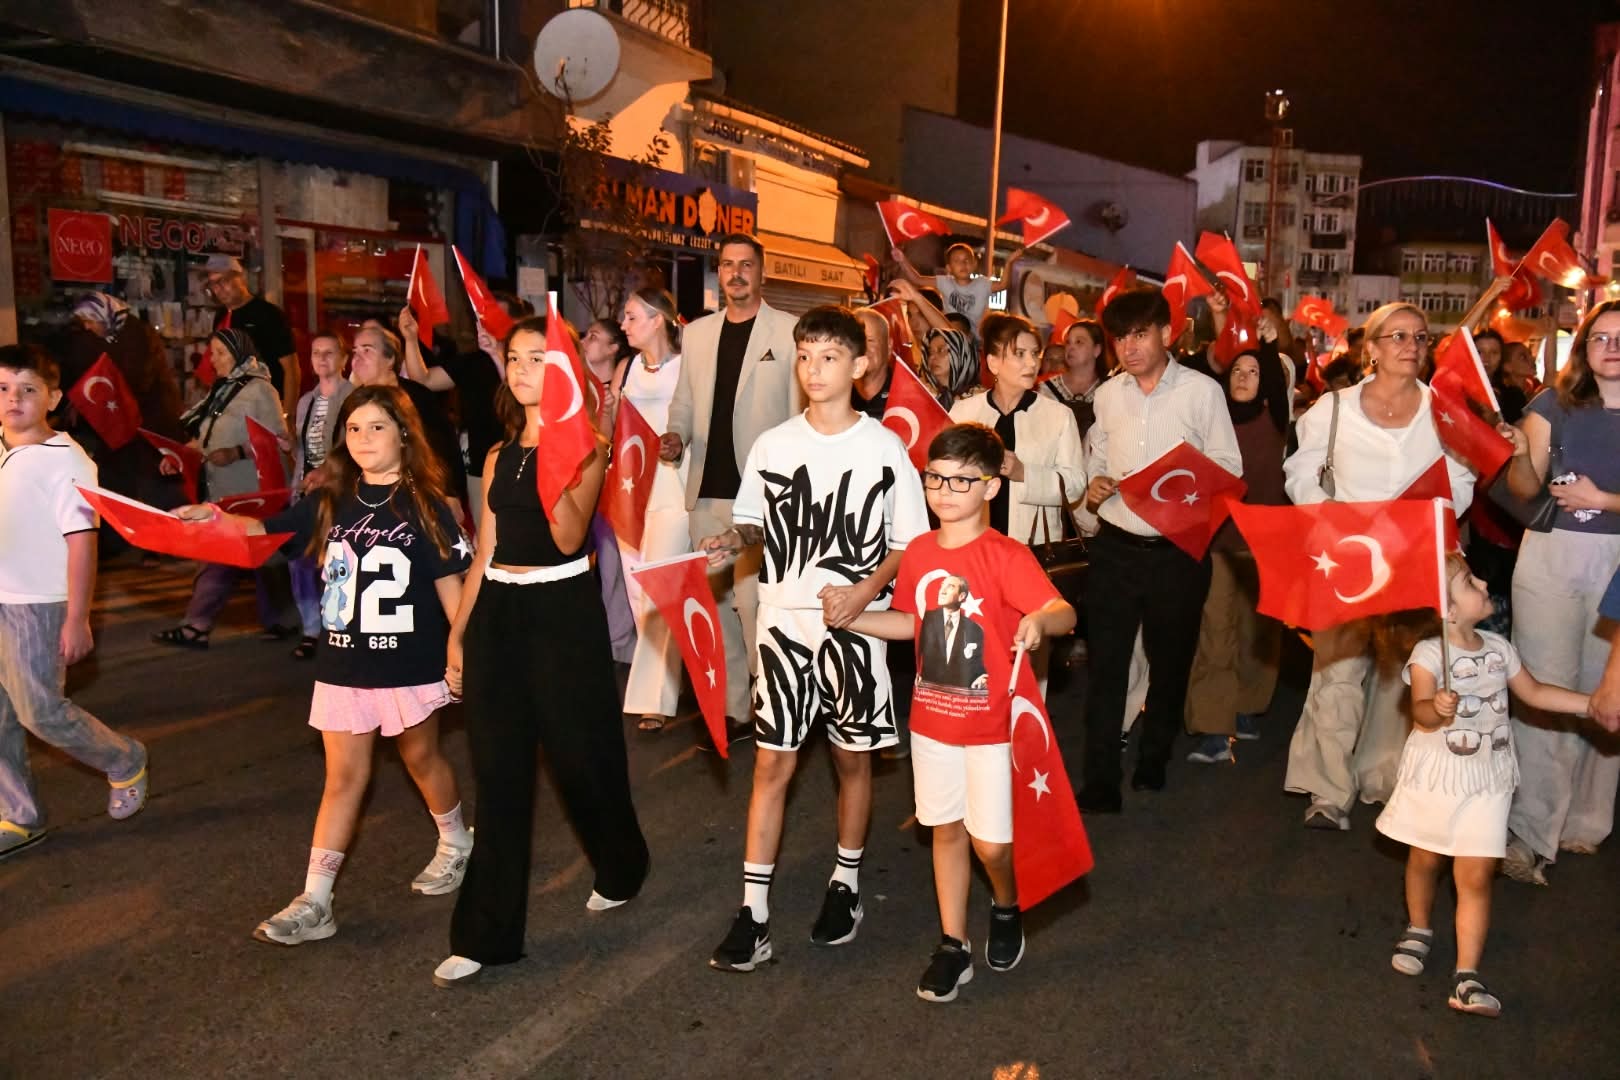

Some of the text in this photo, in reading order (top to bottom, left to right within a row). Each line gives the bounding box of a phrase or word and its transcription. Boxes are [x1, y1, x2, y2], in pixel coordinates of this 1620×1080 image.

[119, 214, 206, 252] NECO
[774, 261, 844, 282] BATILI SAAT
[340, 513, 416, 547] Angeles
[368, 636, 398, 649] 626
